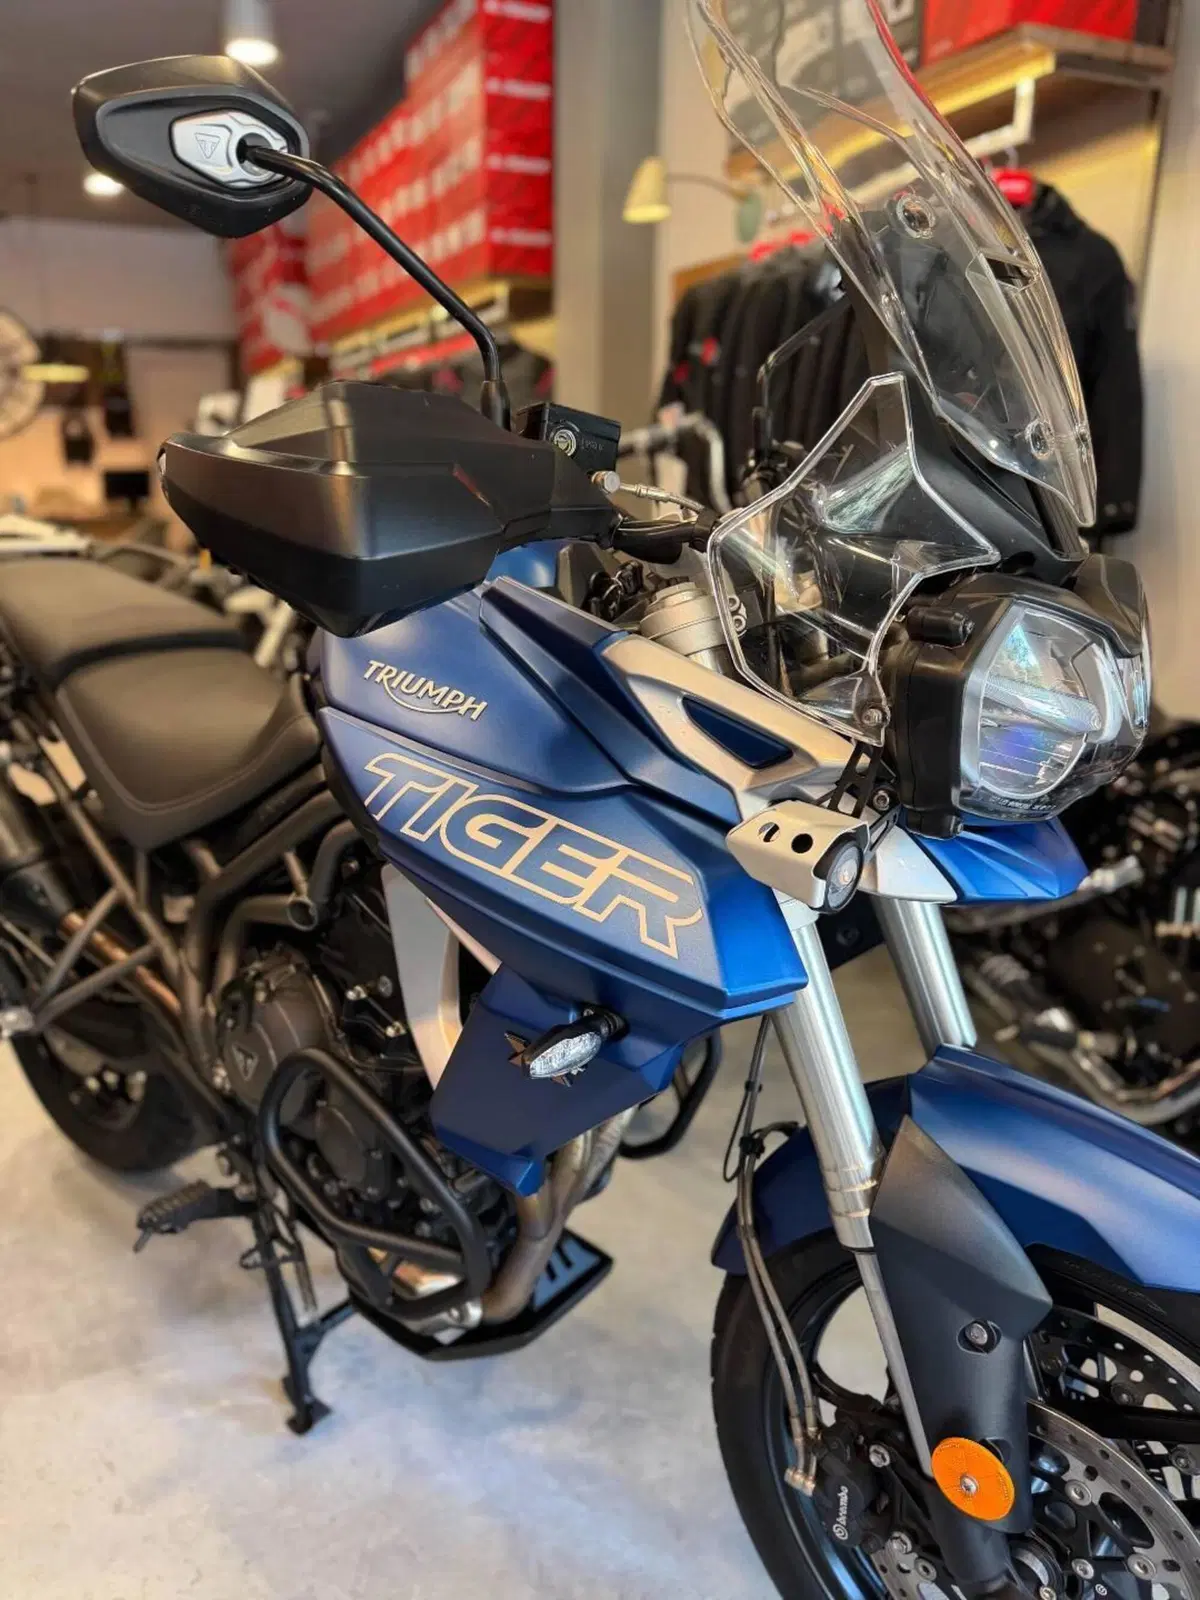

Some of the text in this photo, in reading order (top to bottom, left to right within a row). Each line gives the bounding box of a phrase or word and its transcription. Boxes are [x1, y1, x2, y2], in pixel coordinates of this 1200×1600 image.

[363, 660, 488, 720] TRIUMPH
[363, 752, 704, 959] TIGER
[836, 1485, 849, 1526] brembo
